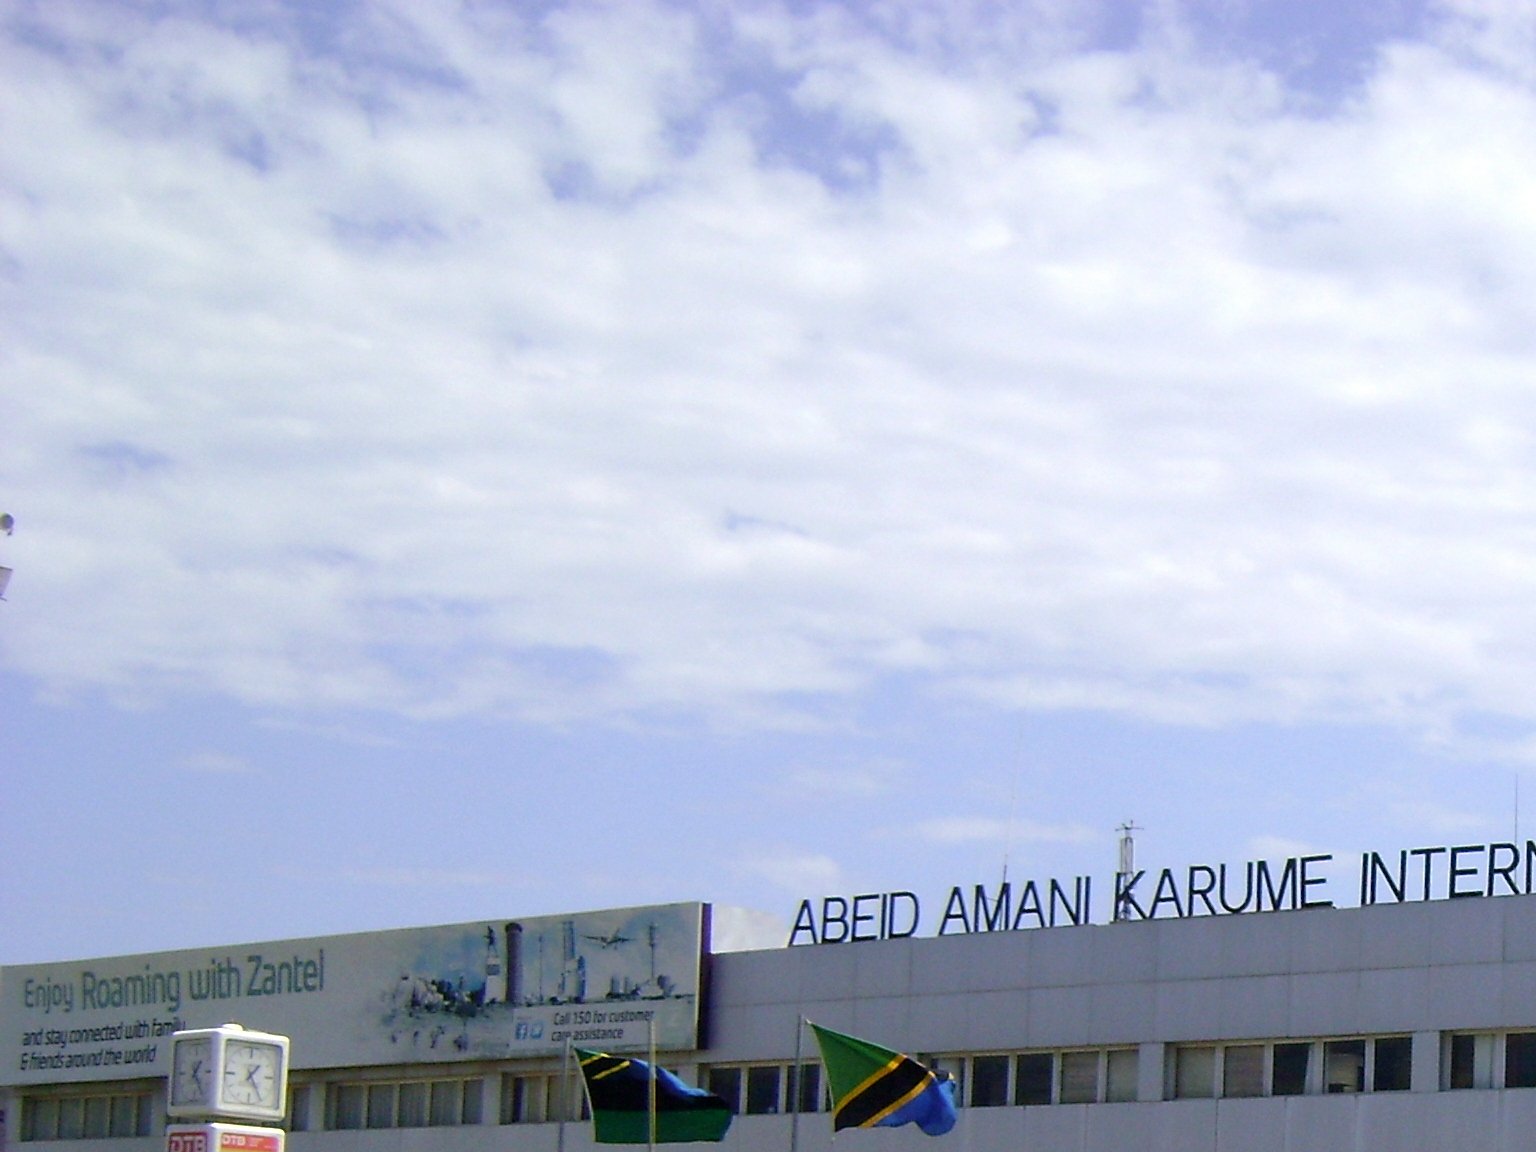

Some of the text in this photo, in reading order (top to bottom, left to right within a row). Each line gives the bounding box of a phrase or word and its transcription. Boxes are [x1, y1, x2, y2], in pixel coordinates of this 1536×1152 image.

[788, 892, 919, 947] ABEID
[938, 876, 1091, 936] AMANI
[1111, 855, 1335, 922] KARUME
[24, 949, 325, 1014] Enjoy Roaming with Zantel
[553, 1009, 655, 1025] Call 150 for customer
[23, 1028, 43, 1046] and
[45, 1027, 67, 1048] stay
[69, 1022, 124, 1043] connected
[125, 1019, 149, 1040] with
[551, 1027, 624, 1042] care assistance
[30, 1050, 64, 1069] friends
[65, 1049, 103, 1068] around
[103, 1049, 122, 1066] the
[124, 1045, 157, 1064] world
[222, 1134, 246, 1146] DTB
